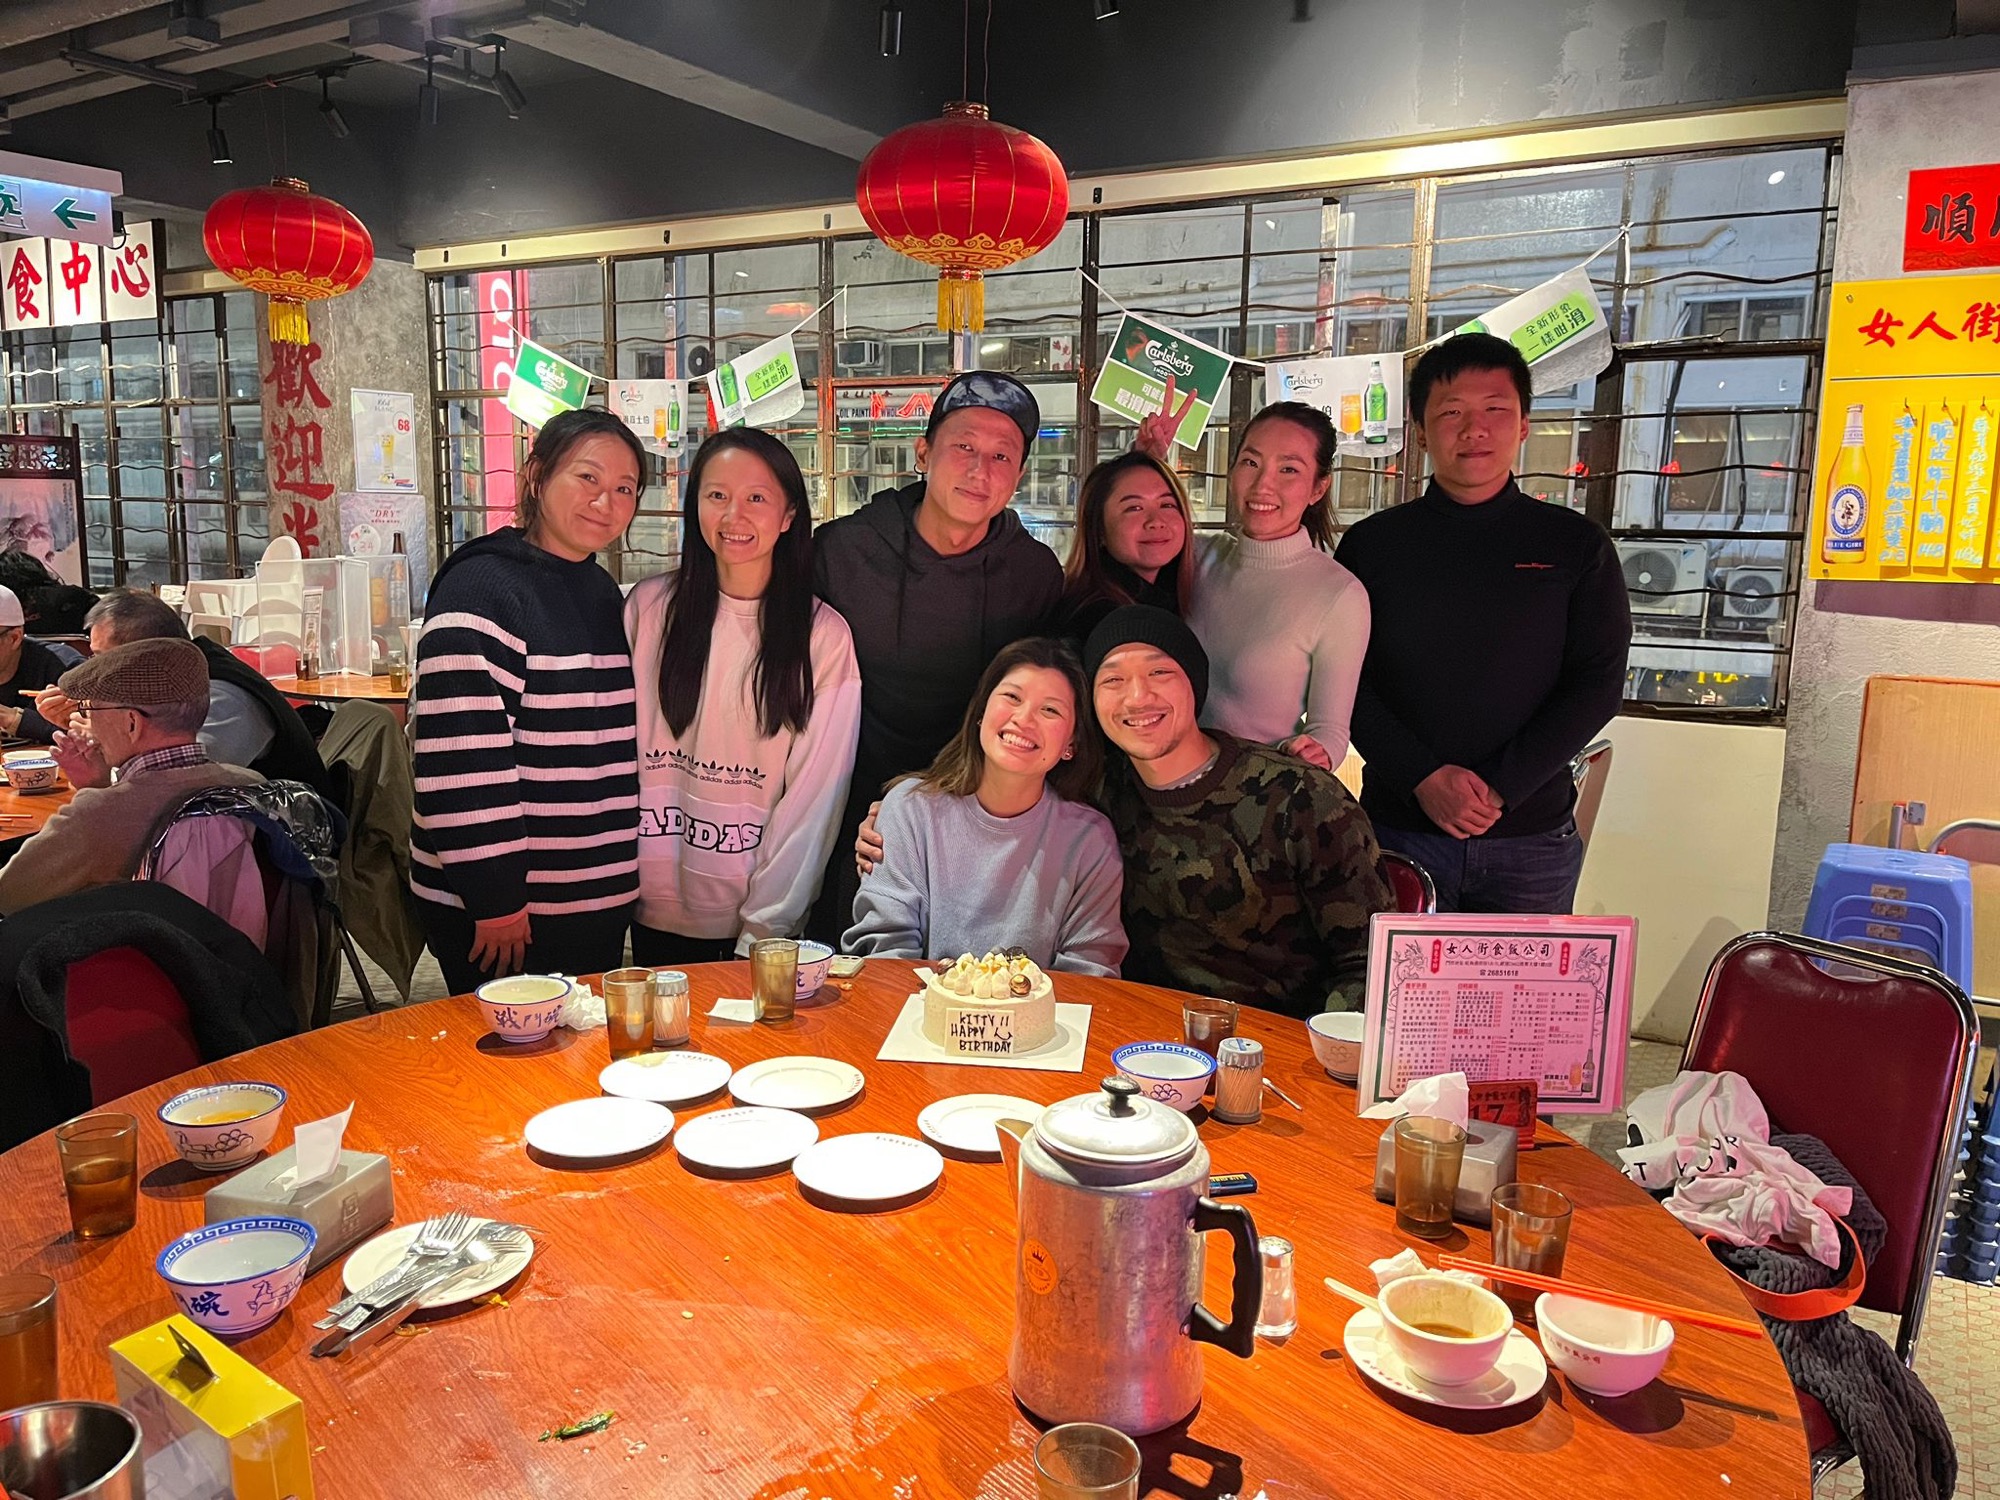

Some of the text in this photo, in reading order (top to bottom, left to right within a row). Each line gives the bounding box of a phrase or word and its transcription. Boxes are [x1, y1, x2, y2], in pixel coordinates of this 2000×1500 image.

[1921, 192, 2000, 244] 順
[6, 242, 153, 322] 食中心
[1525, 302, 1571, 337] 全新形象
[1528, 307, 1586, 351] 一樣咁滑
[1858, 302, 2000, 347] 女人街
[1145, 340, 1194, 377] Carlsberg
[535, 360, 567, 389] Carlsberg
[1284, 374, 1322, 391] Carlsberg
[398, 419, 410, 432] 68
[1845, 541, 1863, 549] GIRL
[645, 763, 667, 771] adidas
[700, 775, 723, 783] adidas
[743, 779, 763, 790] adidas
[638, 806, 764, 853] ADIDAS
[1446, 942, 1550, 956] 女人街食飯公司
[951, 1024, 985, 1038] HAPPY
[960, 1012, 995, 1026] KITTY
[959, 1040, 1012, 1053] BIRTHDAY
[1470, 1104, 1505, 1123] 17
